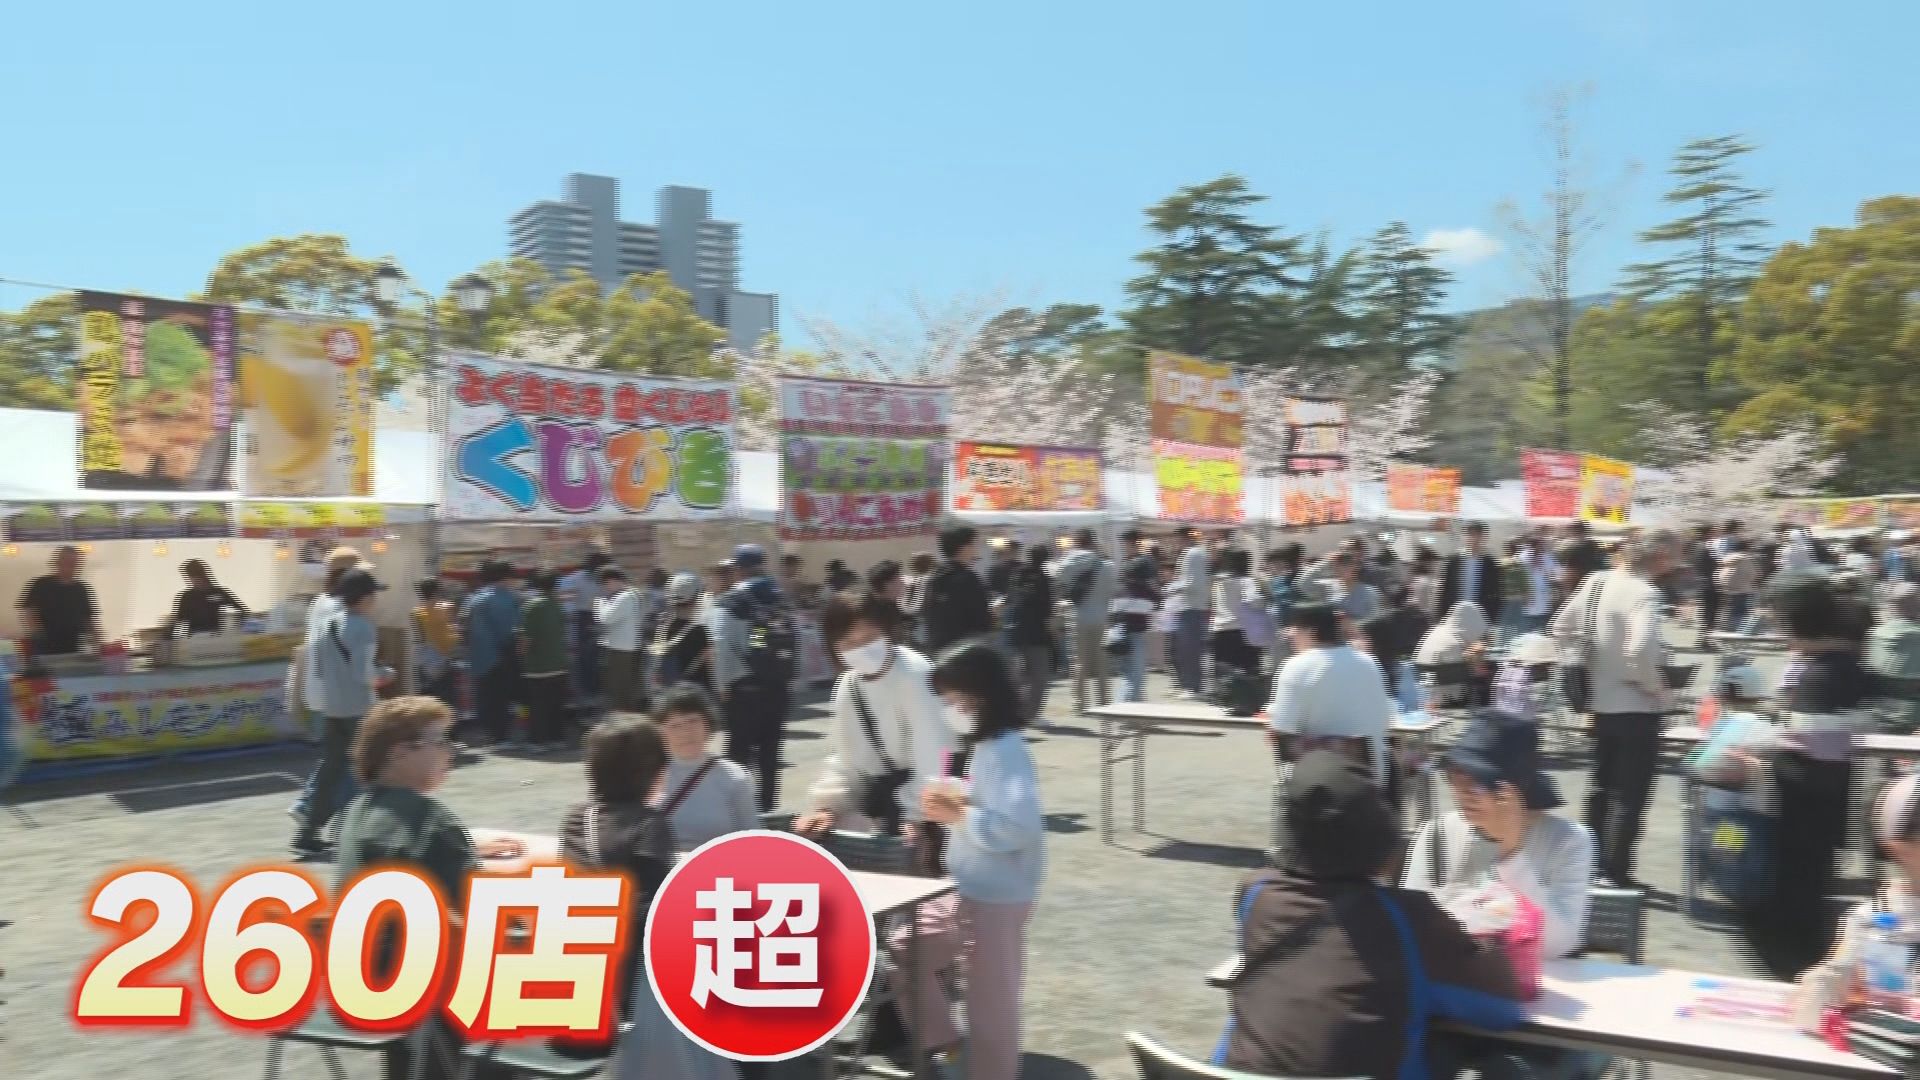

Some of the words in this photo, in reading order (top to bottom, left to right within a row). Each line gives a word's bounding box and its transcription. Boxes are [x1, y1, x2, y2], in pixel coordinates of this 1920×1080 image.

[454, 365, 606, 420] よく当たる
[457, 415, 732, 512] くじびき
[966, 456, 1031, 489] やきとり
